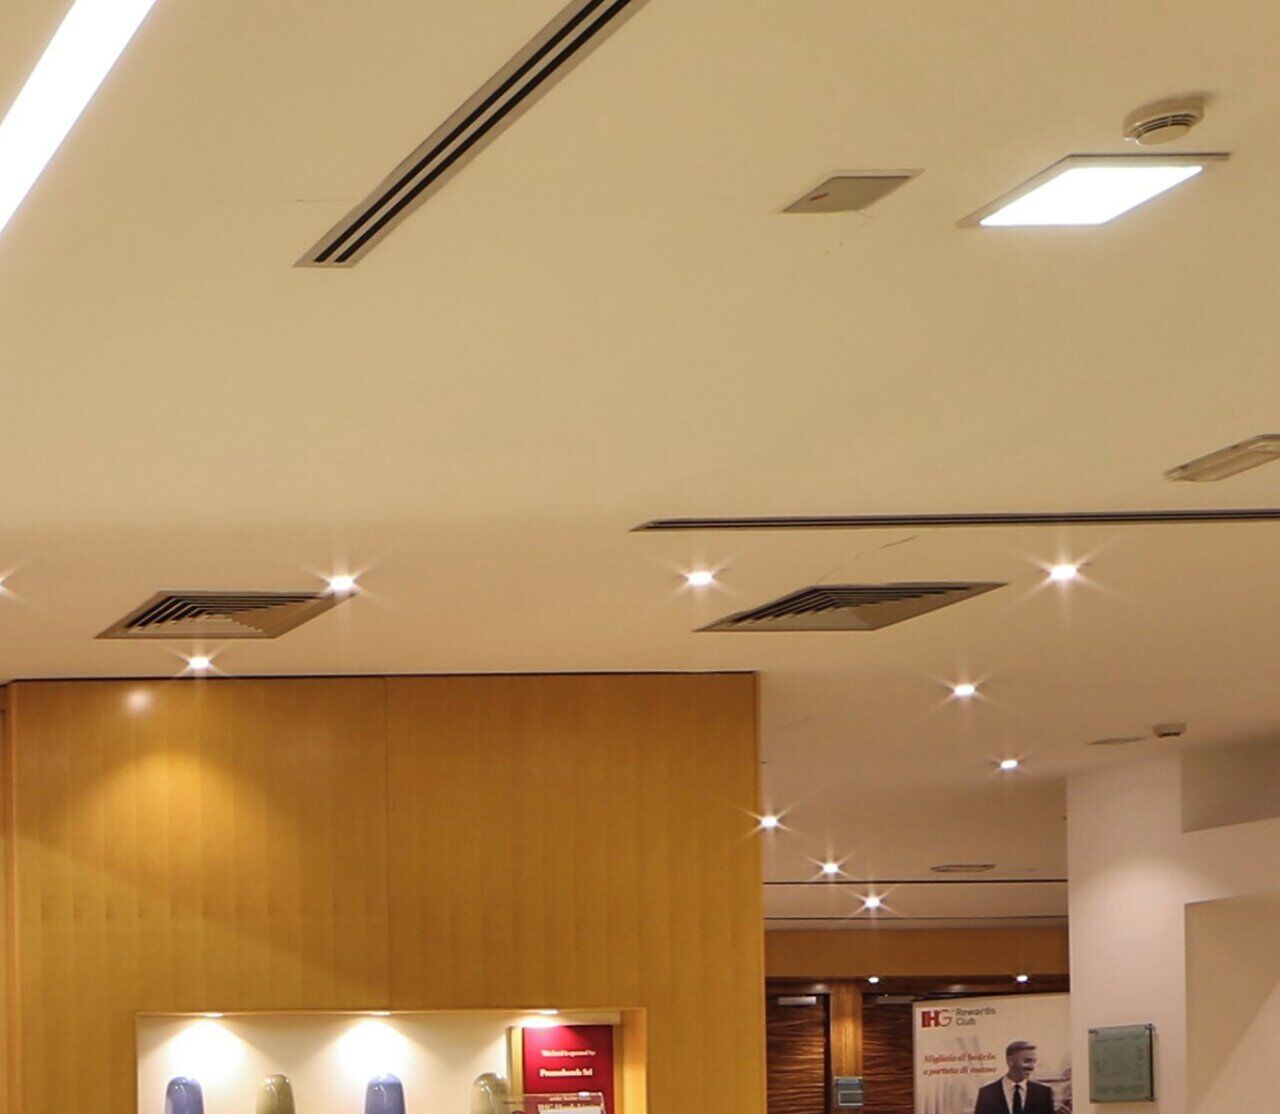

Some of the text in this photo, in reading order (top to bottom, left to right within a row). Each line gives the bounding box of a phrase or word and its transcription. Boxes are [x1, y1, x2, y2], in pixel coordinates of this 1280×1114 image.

[921, 1007, 996, 1028] IHG Rewards
[956, 1017, 976, 1026] Club
